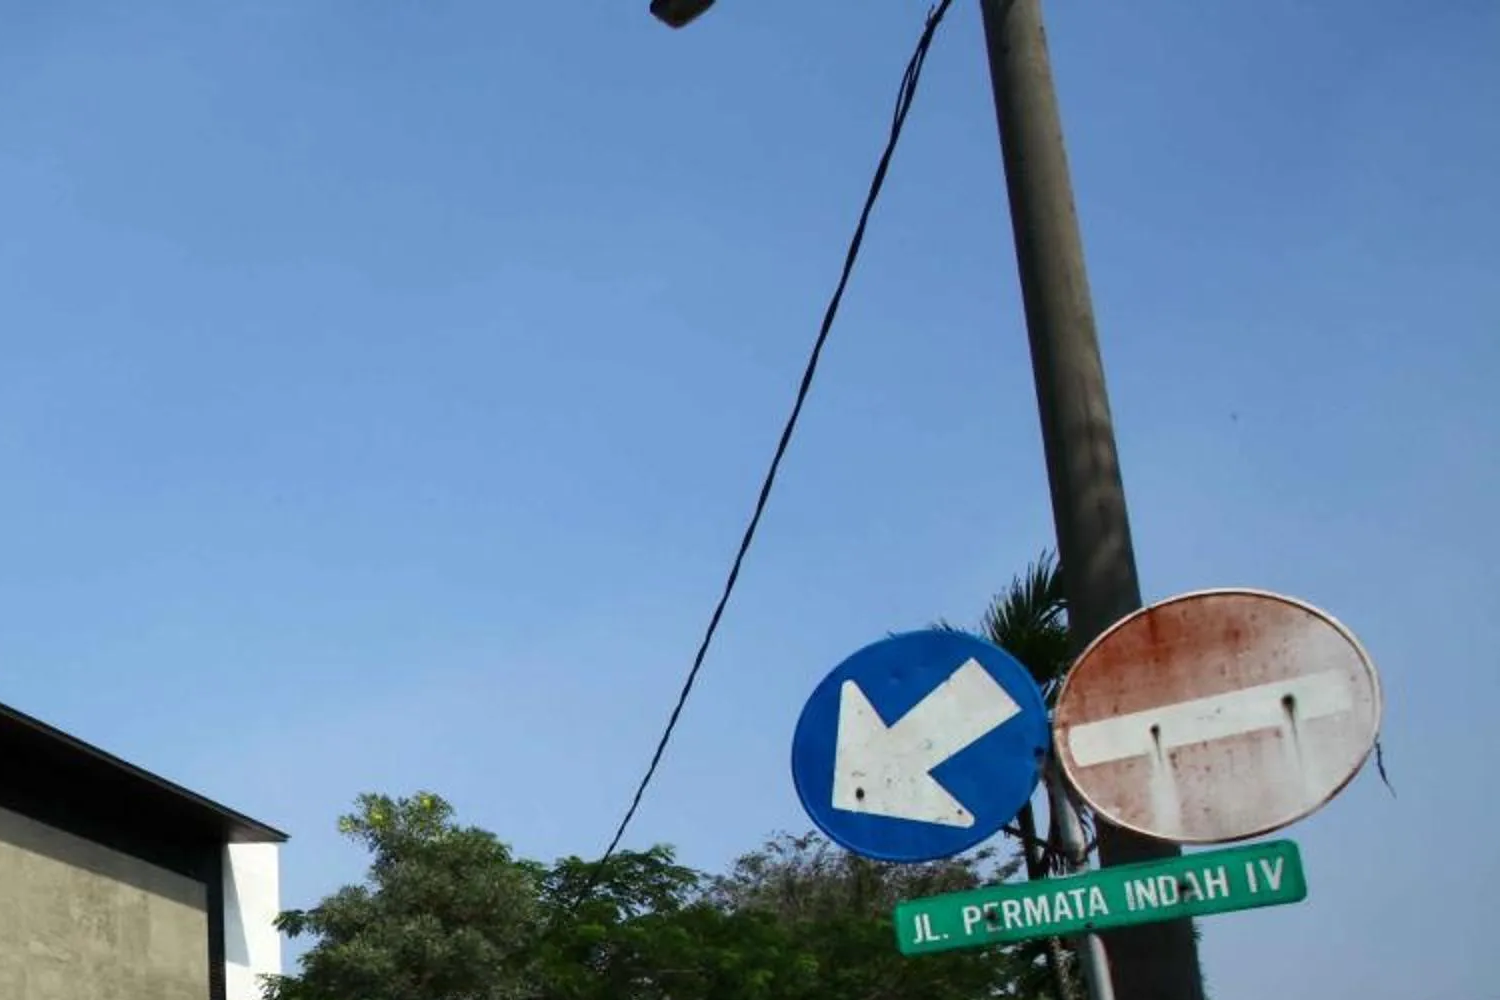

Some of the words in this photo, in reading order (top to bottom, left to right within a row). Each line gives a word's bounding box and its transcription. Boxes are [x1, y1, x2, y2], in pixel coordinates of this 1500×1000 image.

[912, 913, 950, 945] JL.
[961, 886, 1109, 936] PERMATA
[1124, 865, 1230, 912] INDAH
[1245, 856, 1284, 894] IV
